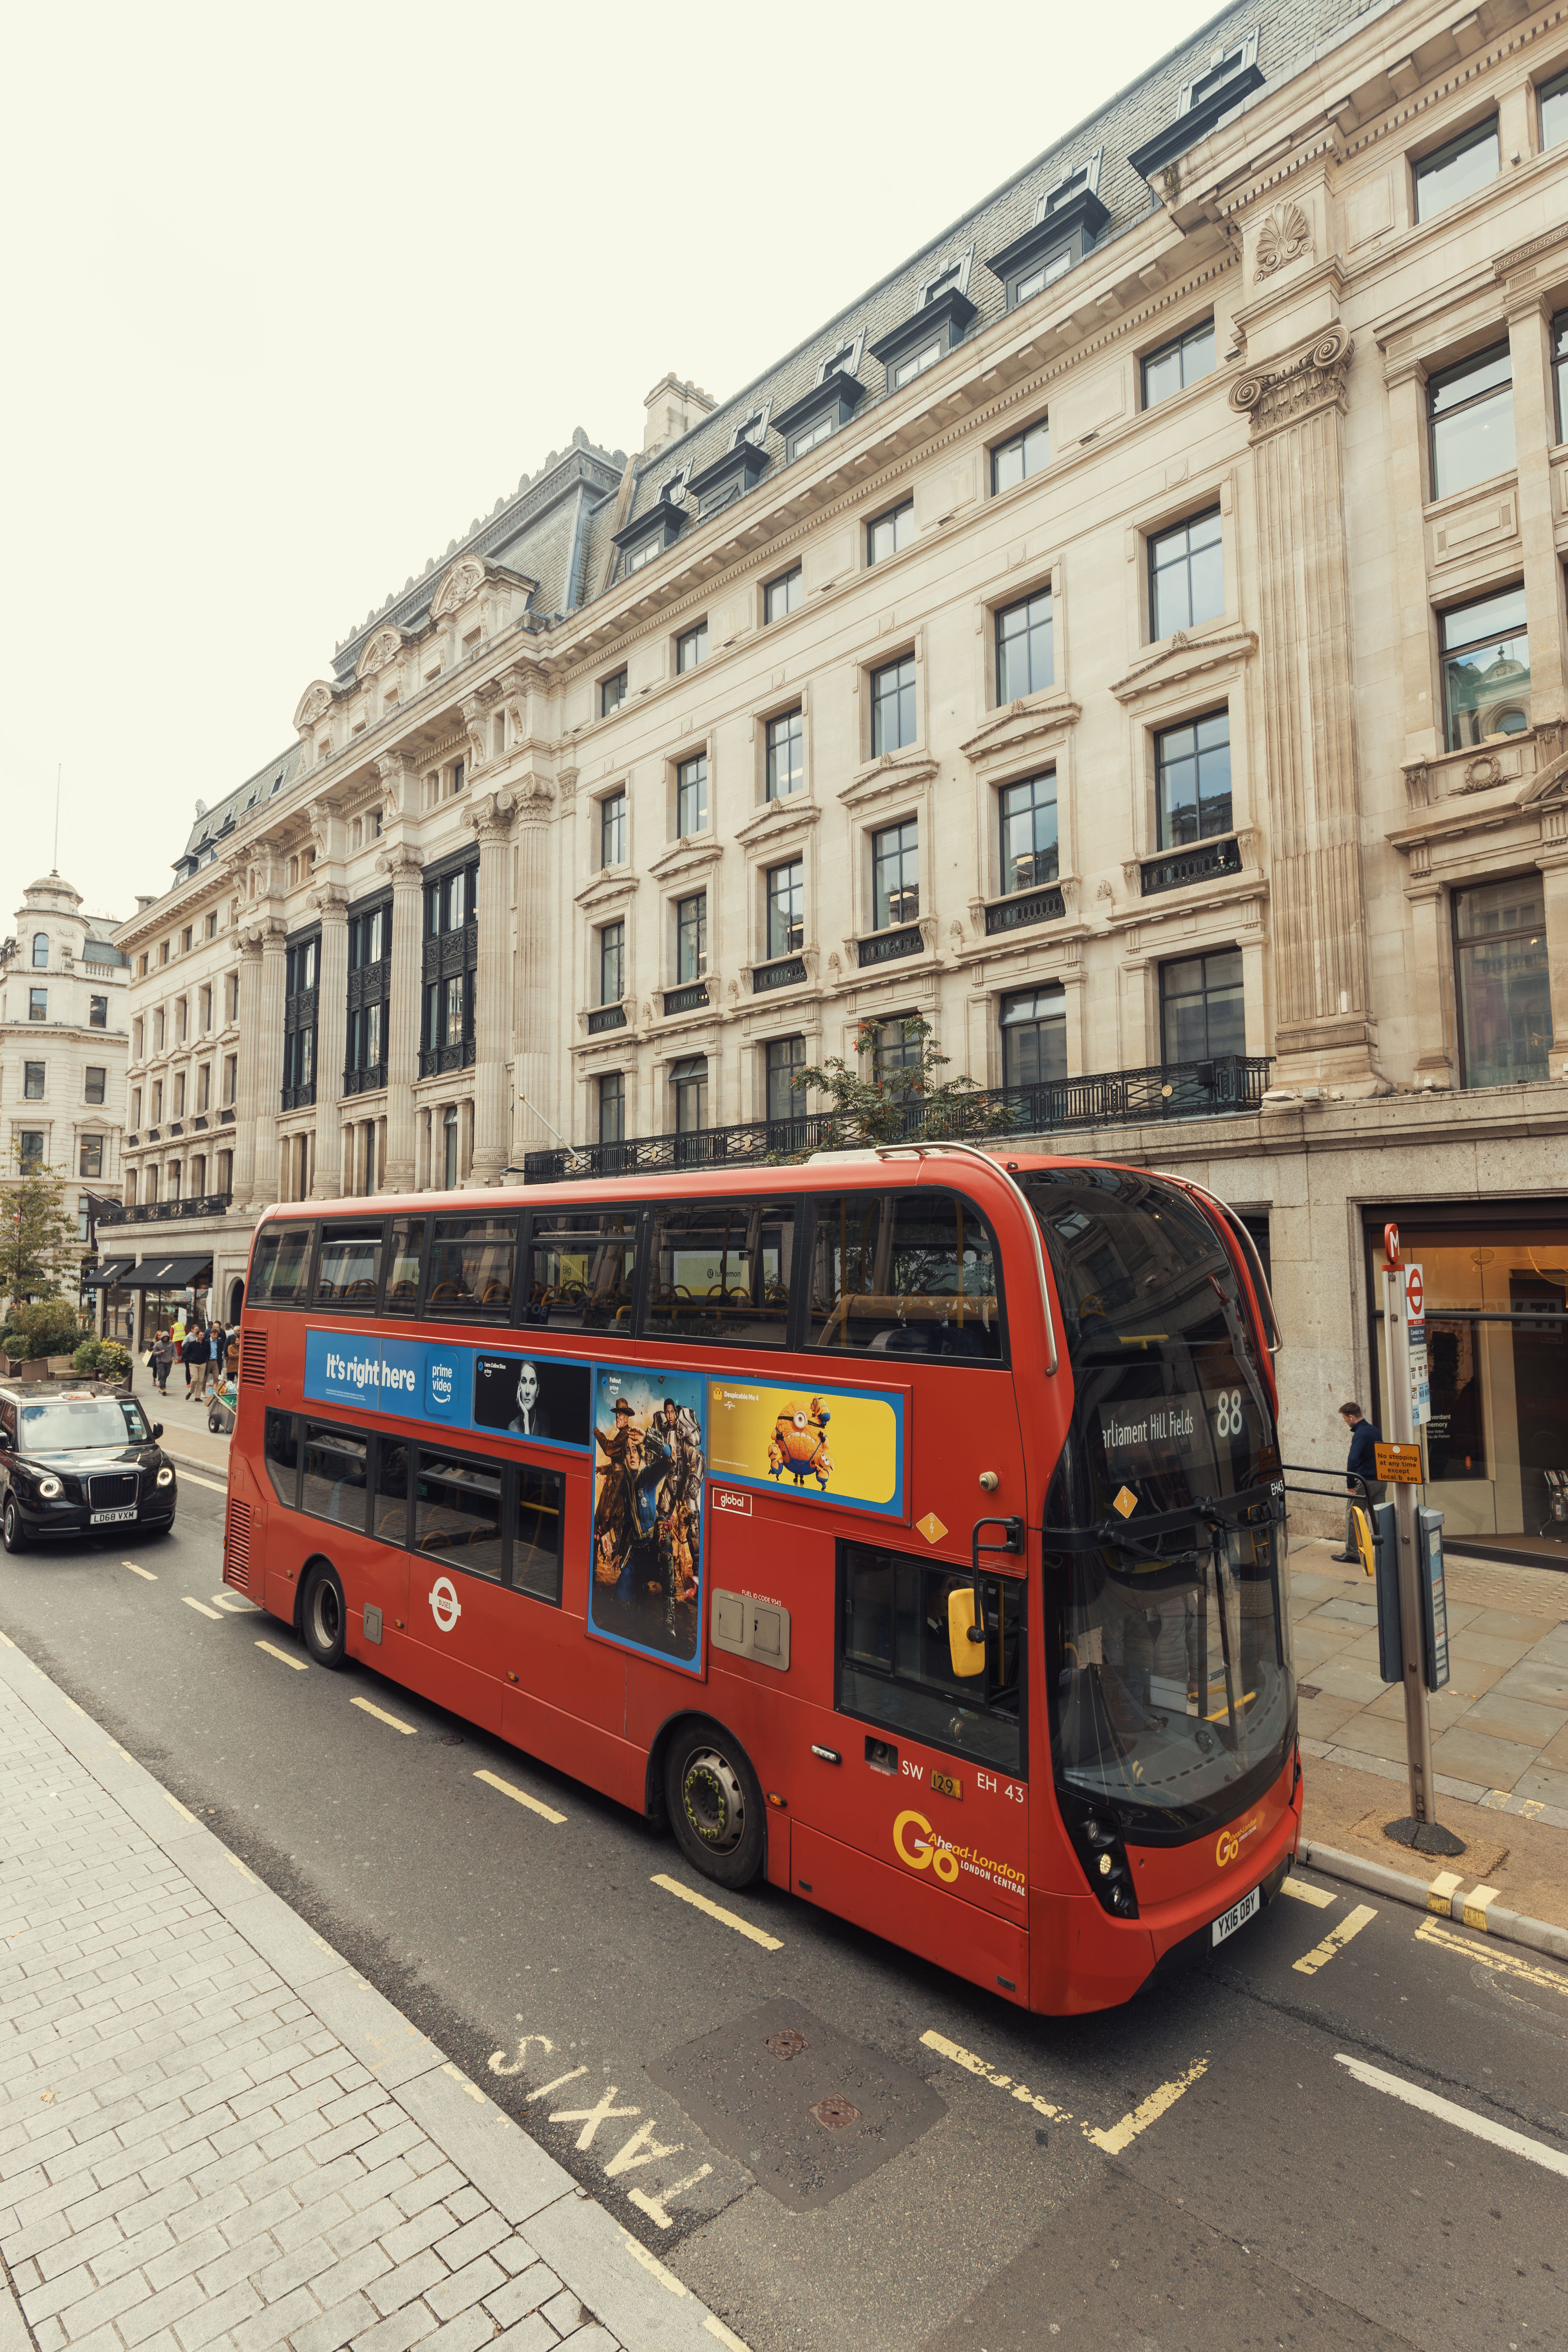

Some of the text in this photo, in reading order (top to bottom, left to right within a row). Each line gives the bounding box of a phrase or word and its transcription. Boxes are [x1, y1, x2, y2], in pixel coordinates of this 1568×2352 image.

[1390, 1230, 1400, 1257] M
[563, 1265, 571, 1276] Big
[347, 1356, 379, 1388] right
[382, 1361, 415, 1391] here
[432, 1364, 452, 1378] prime
[433, 1378, 451, 1393] video
[724, 1391, 748, 1400] Despicable
[1217, 1389, 1242, 1437] 88
[1102, 1420, 1147, 1448] arliament
[1150, 1412, 1167, 1440] Hill
[1169, 1409, 1193, 1437] Fields
[1271, 1480, 1284, 1495] EH43
[721, 1493, 744, 1507] global
[94, 1511, 134, 1522] LD68 VXM
[439, 1599, 450, 1609] BUSES
[758, 1595, 770, 1603] CODE
[870, 1765, 881, 1773] SCREEN
[902, 1760, 923, 1780] SW
[933, 1773, 953, 1793] 129
[977, 1772, 1023, 1803] EH 43
[1239, 1825, 1257, 1842] LONDON CENTRAL
[960, 1860, 1025, 1896] LONDON CENTRAL
[1219, 1893, 1255, 1937] YX16 OBY
[487, 2035, 713, 2229] TAXIS
